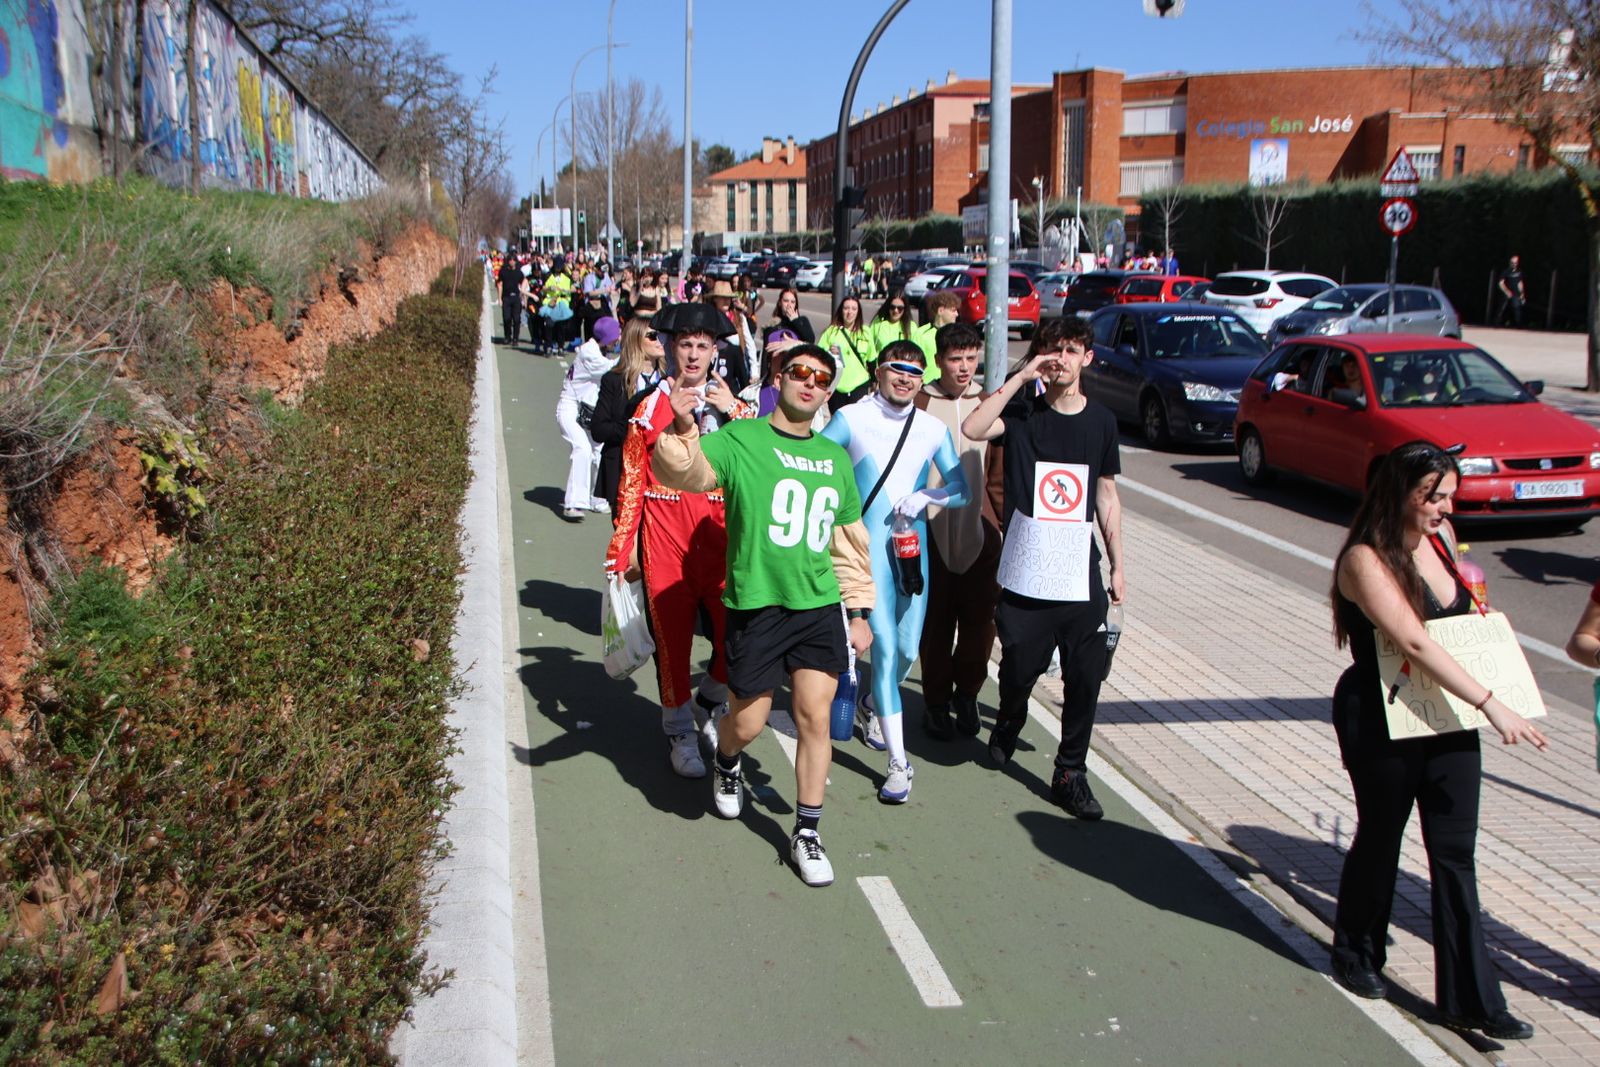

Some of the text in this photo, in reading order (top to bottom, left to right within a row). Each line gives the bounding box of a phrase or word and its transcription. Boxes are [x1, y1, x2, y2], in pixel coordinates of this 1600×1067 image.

[1270, 114, 1303, 134] San
[1308, 113, 1354, 134] José
[1388, 207, 1409, 223] 30
[773, 447, 833, 476] EAGLES
[768, 478, 840, 553] 96
[1405, 699, 1448, 733] AL
